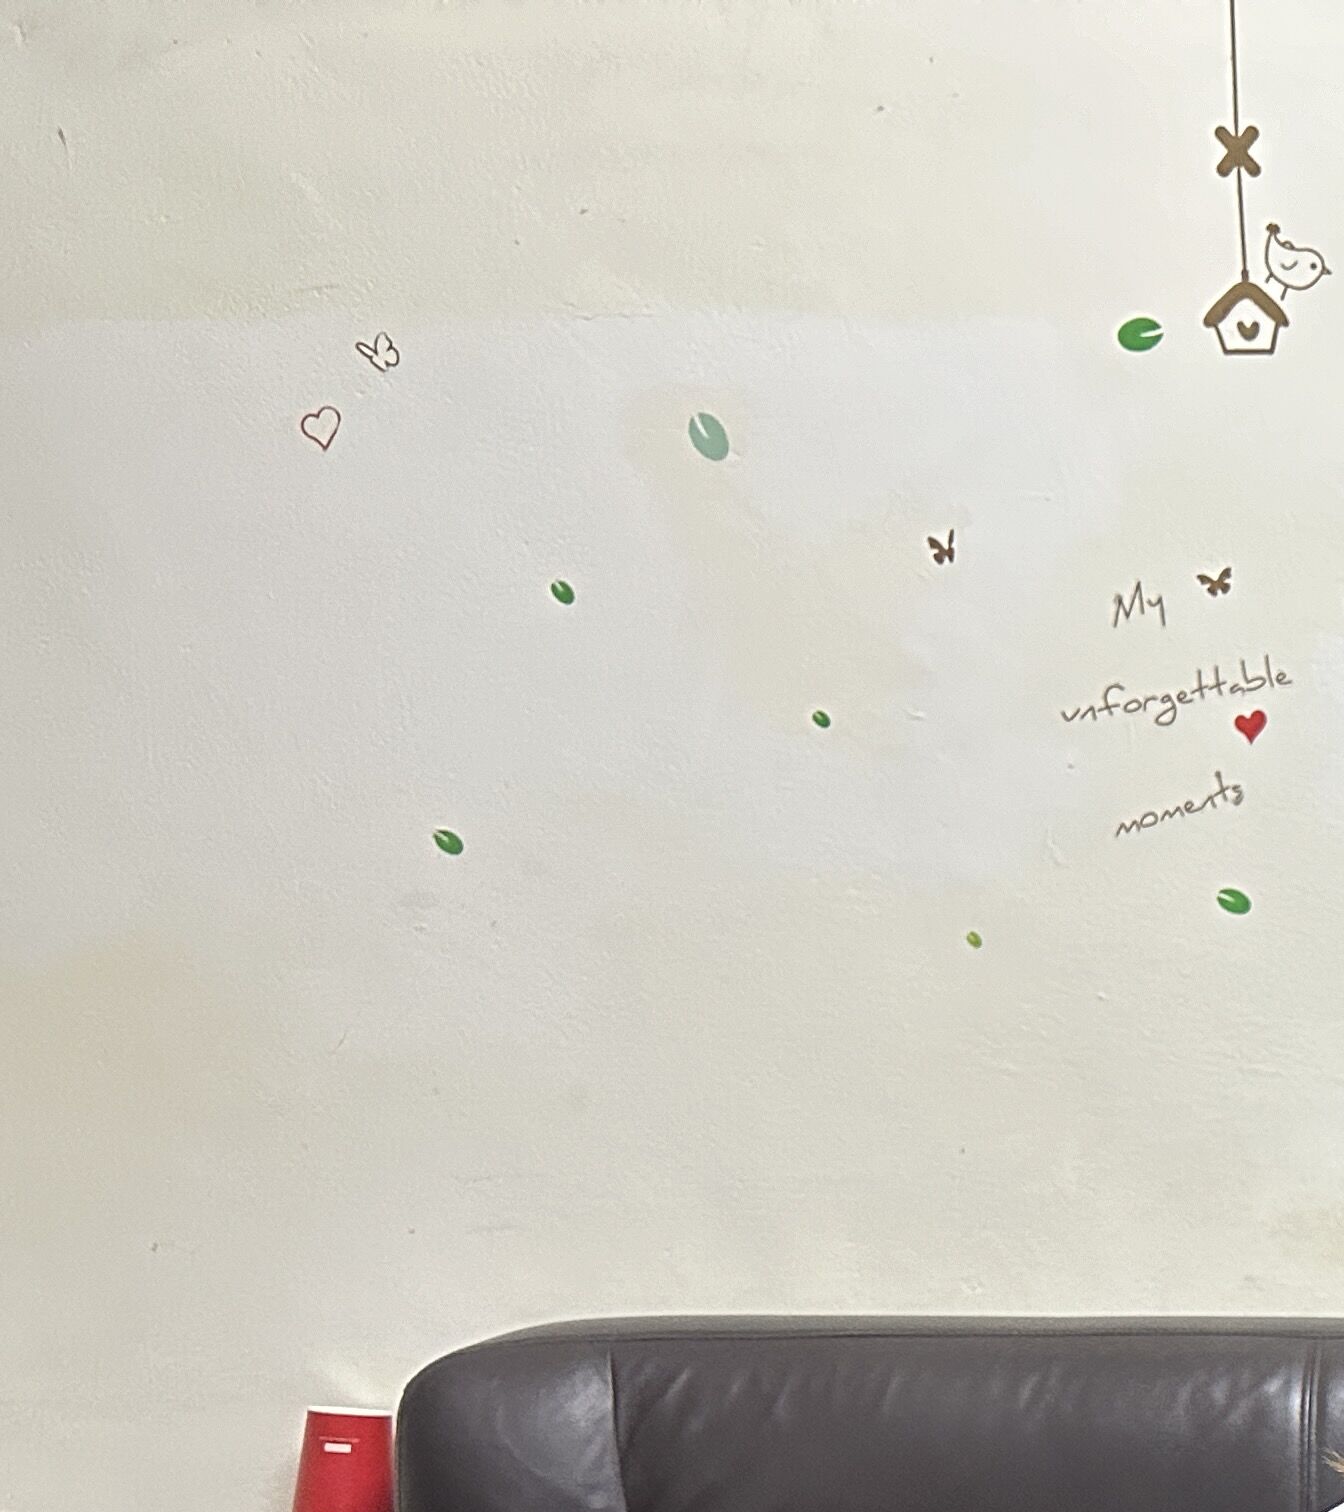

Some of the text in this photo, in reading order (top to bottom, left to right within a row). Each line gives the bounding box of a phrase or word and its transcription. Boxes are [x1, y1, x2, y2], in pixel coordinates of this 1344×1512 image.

[1113, 580, 1166, 628] My
[1061, 654, 1292, 726] unforgettable
[1115, 771, 1244, 838] moments
